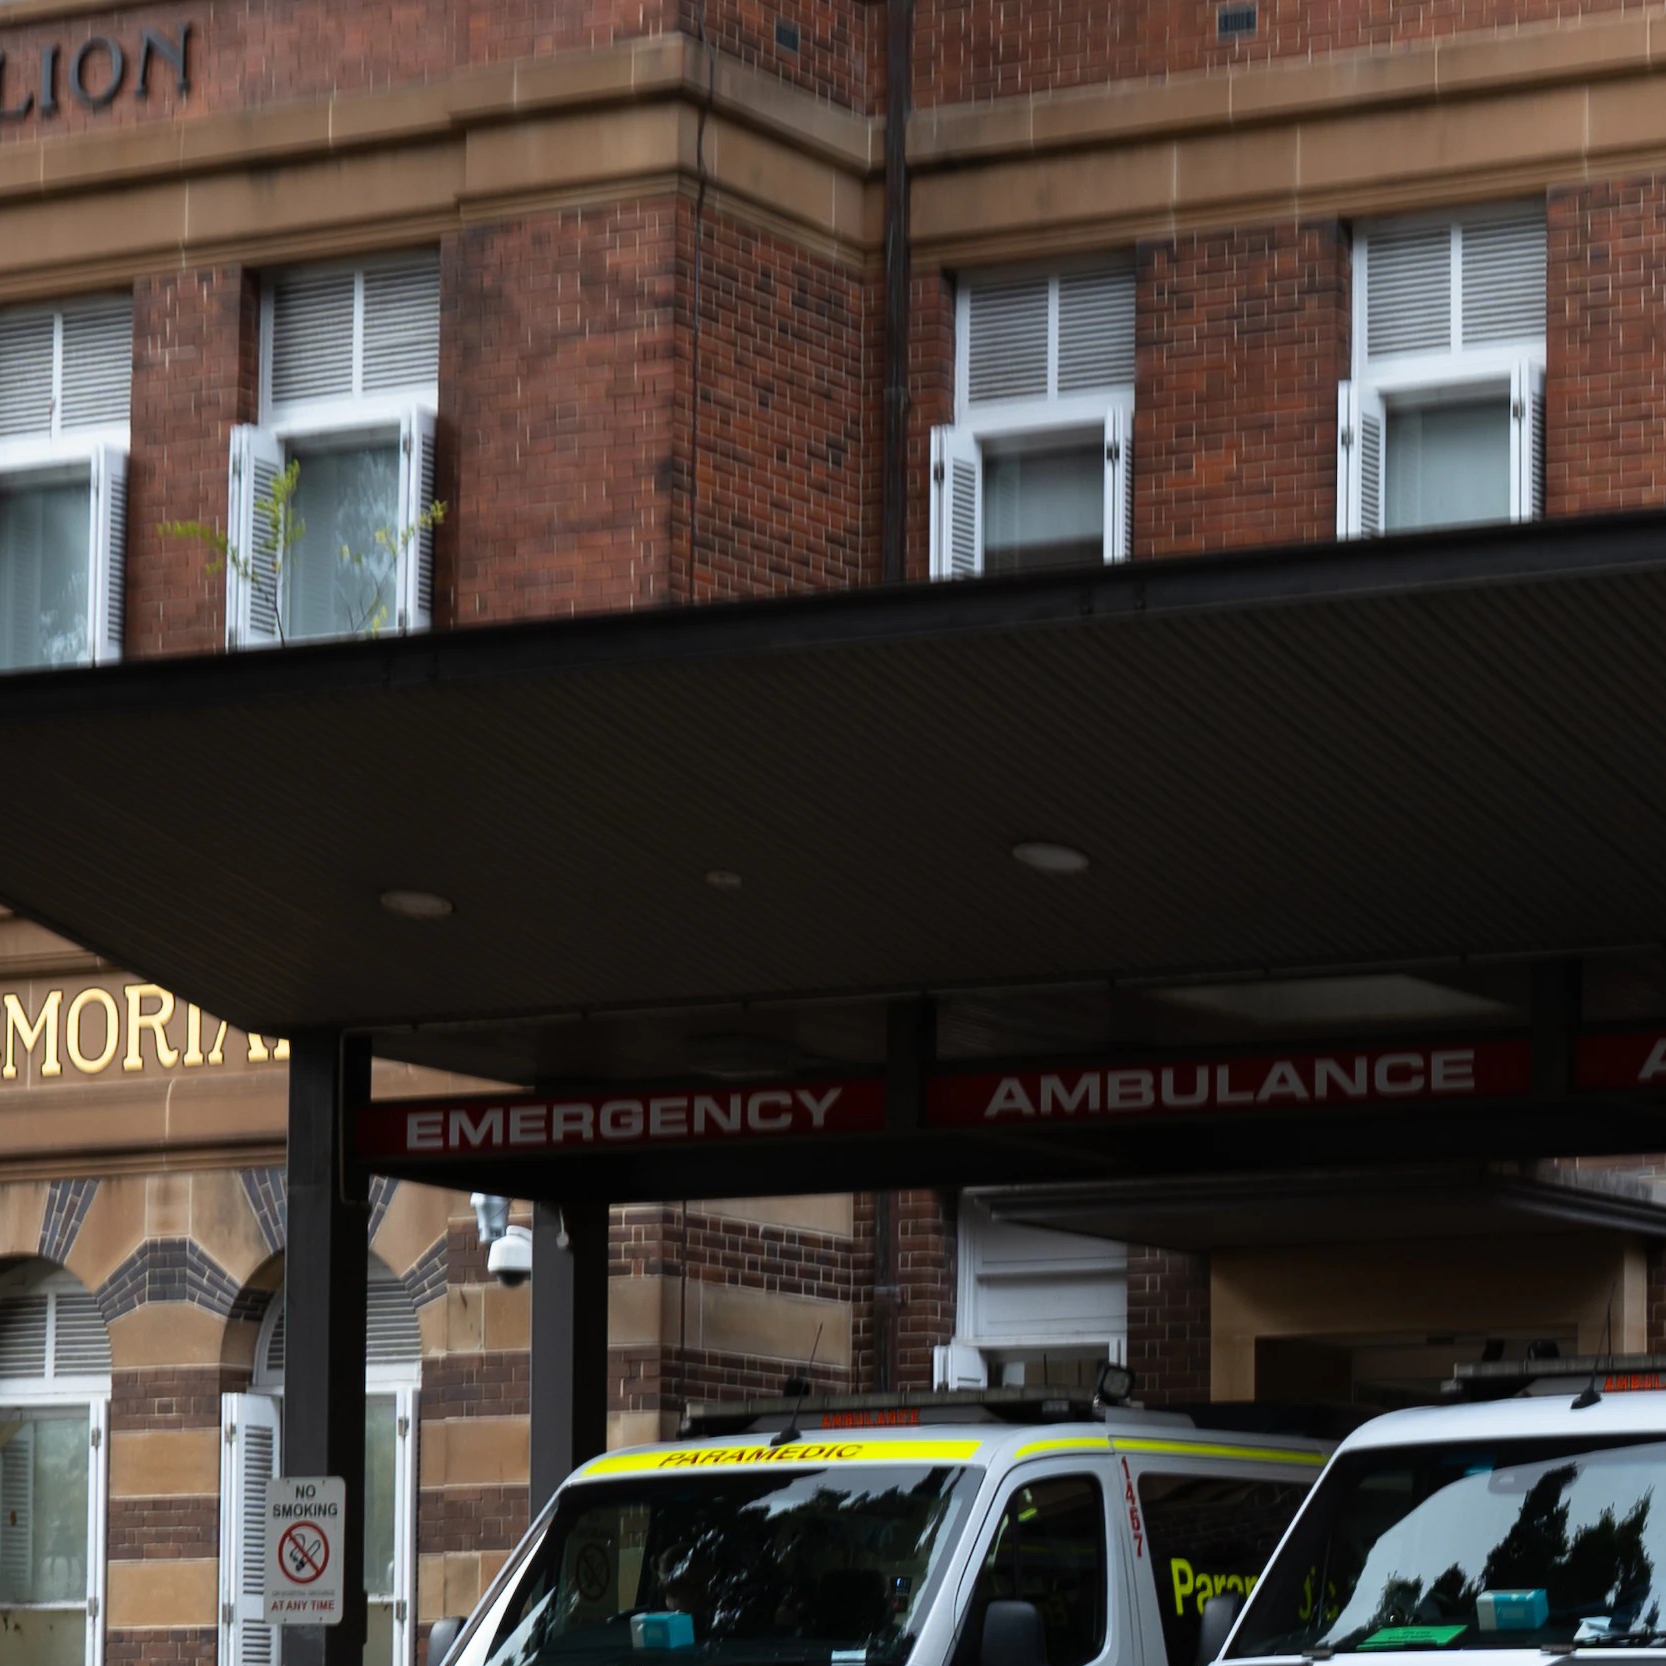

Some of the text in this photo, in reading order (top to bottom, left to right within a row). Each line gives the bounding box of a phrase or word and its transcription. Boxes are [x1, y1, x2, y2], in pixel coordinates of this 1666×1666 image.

[982, 1049, 1476, 1119] AMBULANCE
[404, 1087, 842, 1151] EMERGENCY
[821, 1408, 921, 1429] AMBULANCE
[659, 1444, 863, 1467] PARAMEDIC
[295, 1484, 316, 1499] NO
[273, 1503, 338, 1517] SMOKING
[271, 1600, 335, 1611] AT ANY TIME
